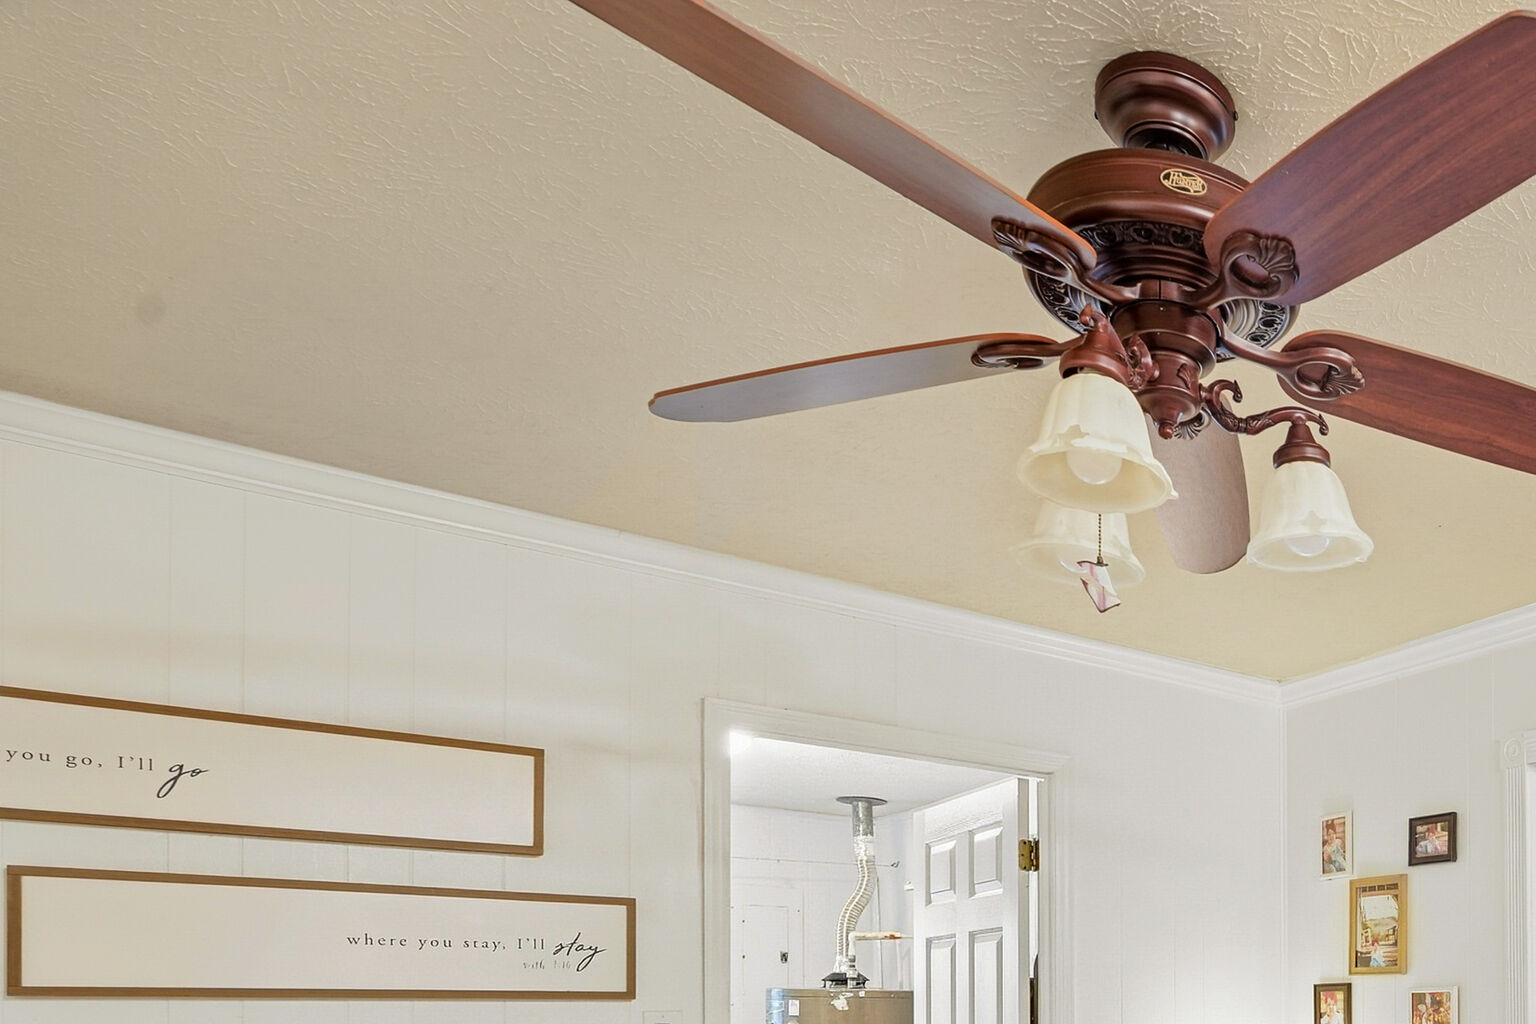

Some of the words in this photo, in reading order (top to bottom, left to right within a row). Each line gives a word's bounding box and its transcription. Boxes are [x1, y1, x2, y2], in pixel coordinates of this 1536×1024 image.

[6, 750, 51, 762] you
[66, 755, 103, 769] go,
[118, 756, 153, 771] I'll
[157, 763, 209, 799] go
[346, 933, 408, 947] where
[418, 936, 453, 950] you
[463, 938, 507, 952] stay,
[517, 938, 545, 950] I'll
[552, 931, 608, 973] stay
